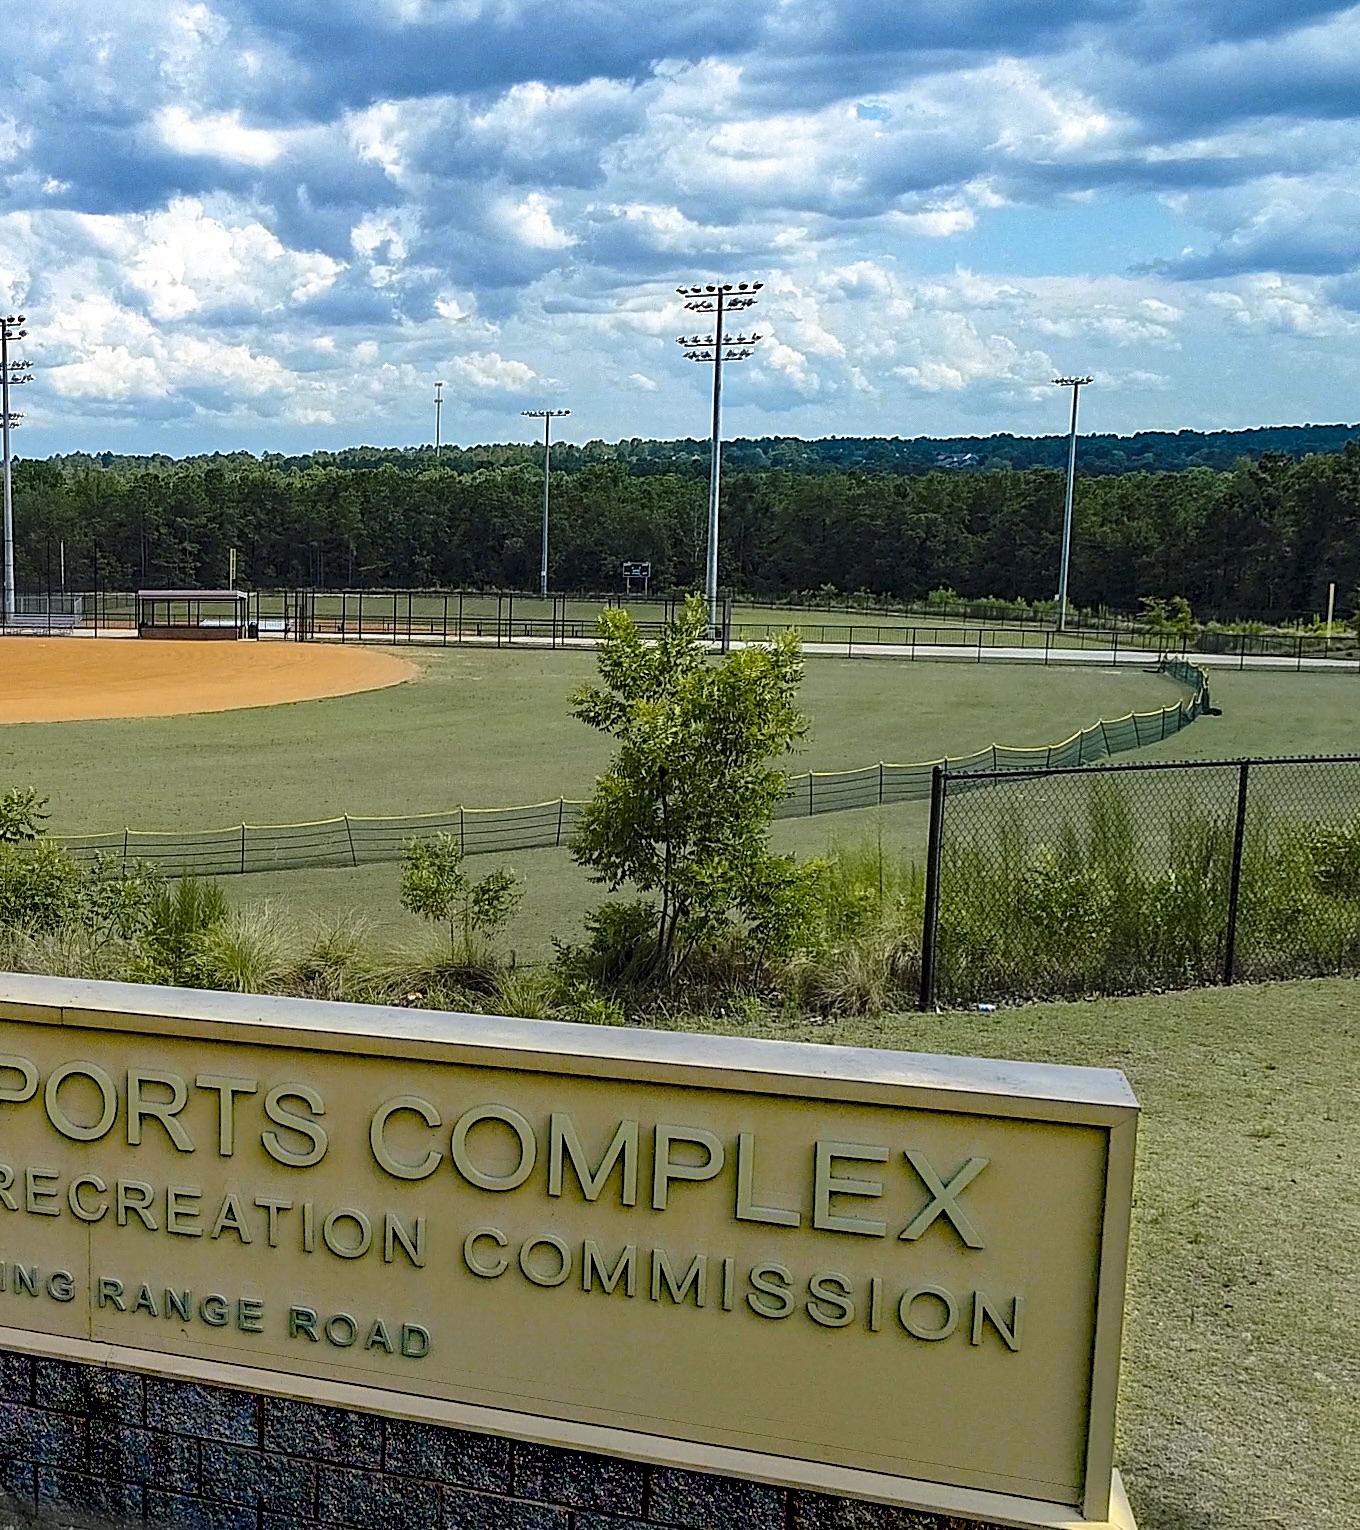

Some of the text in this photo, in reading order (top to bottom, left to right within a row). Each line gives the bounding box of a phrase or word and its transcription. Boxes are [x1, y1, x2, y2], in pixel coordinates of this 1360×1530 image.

[369, 1095, 990, 1250] COMPLEX
[98, 1276, 264, 1333] RANGE
[289, 1304, 431, 1358] ROAD
[463, 1226, 1024, 1352] COMMISSION
